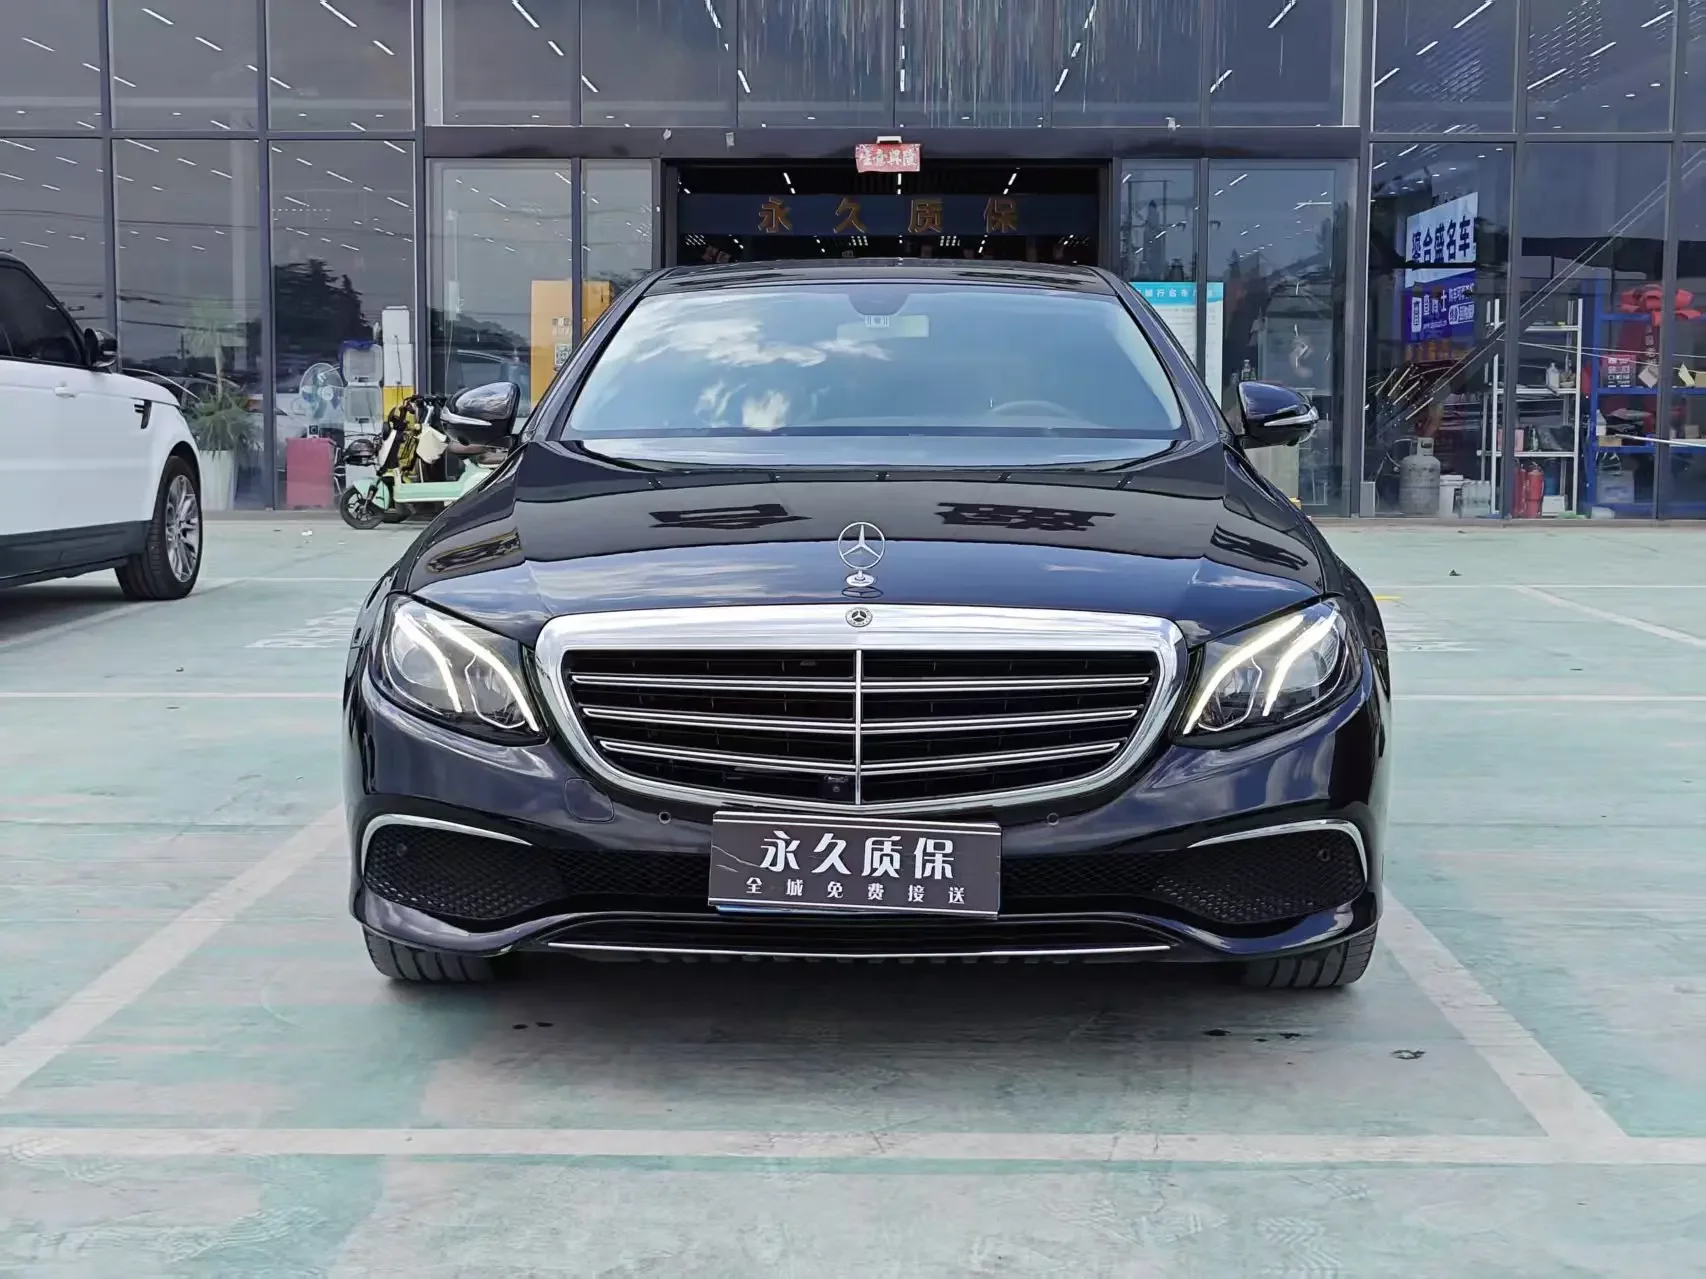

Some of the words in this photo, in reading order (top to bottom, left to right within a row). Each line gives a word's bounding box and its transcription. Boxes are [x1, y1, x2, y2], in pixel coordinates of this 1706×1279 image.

[758, 196, 1019, 234] 永久质保
[759, 830, 955, 880] 永久质保
[745, 877, 965, 905] 全城免费接送
